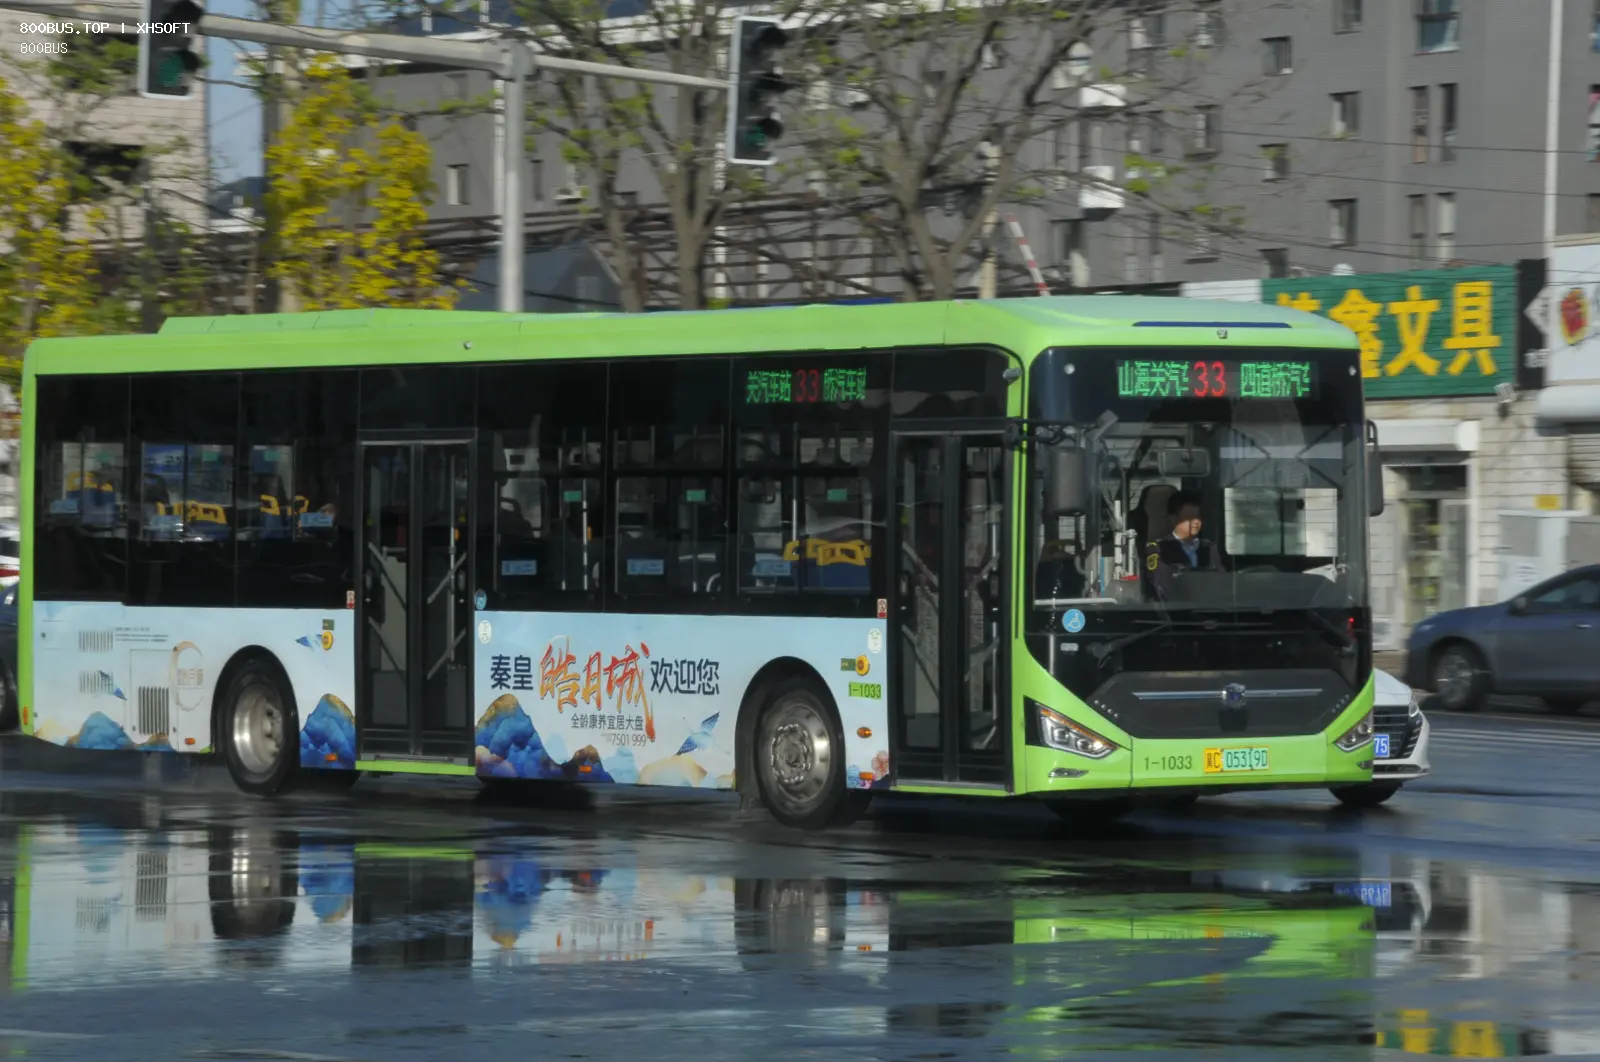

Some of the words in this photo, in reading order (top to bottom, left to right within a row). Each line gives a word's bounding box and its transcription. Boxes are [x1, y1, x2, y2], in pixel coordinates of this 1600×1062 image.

[795, 369, 820, 402] 33
[1193, 361, 1226, 398] 33
[848, 682, 882, 699] 1-1033
[571, 713, 644, 731] 全龄康养宜居大盘
[1143, 755, 1193, 771] 1-1033
